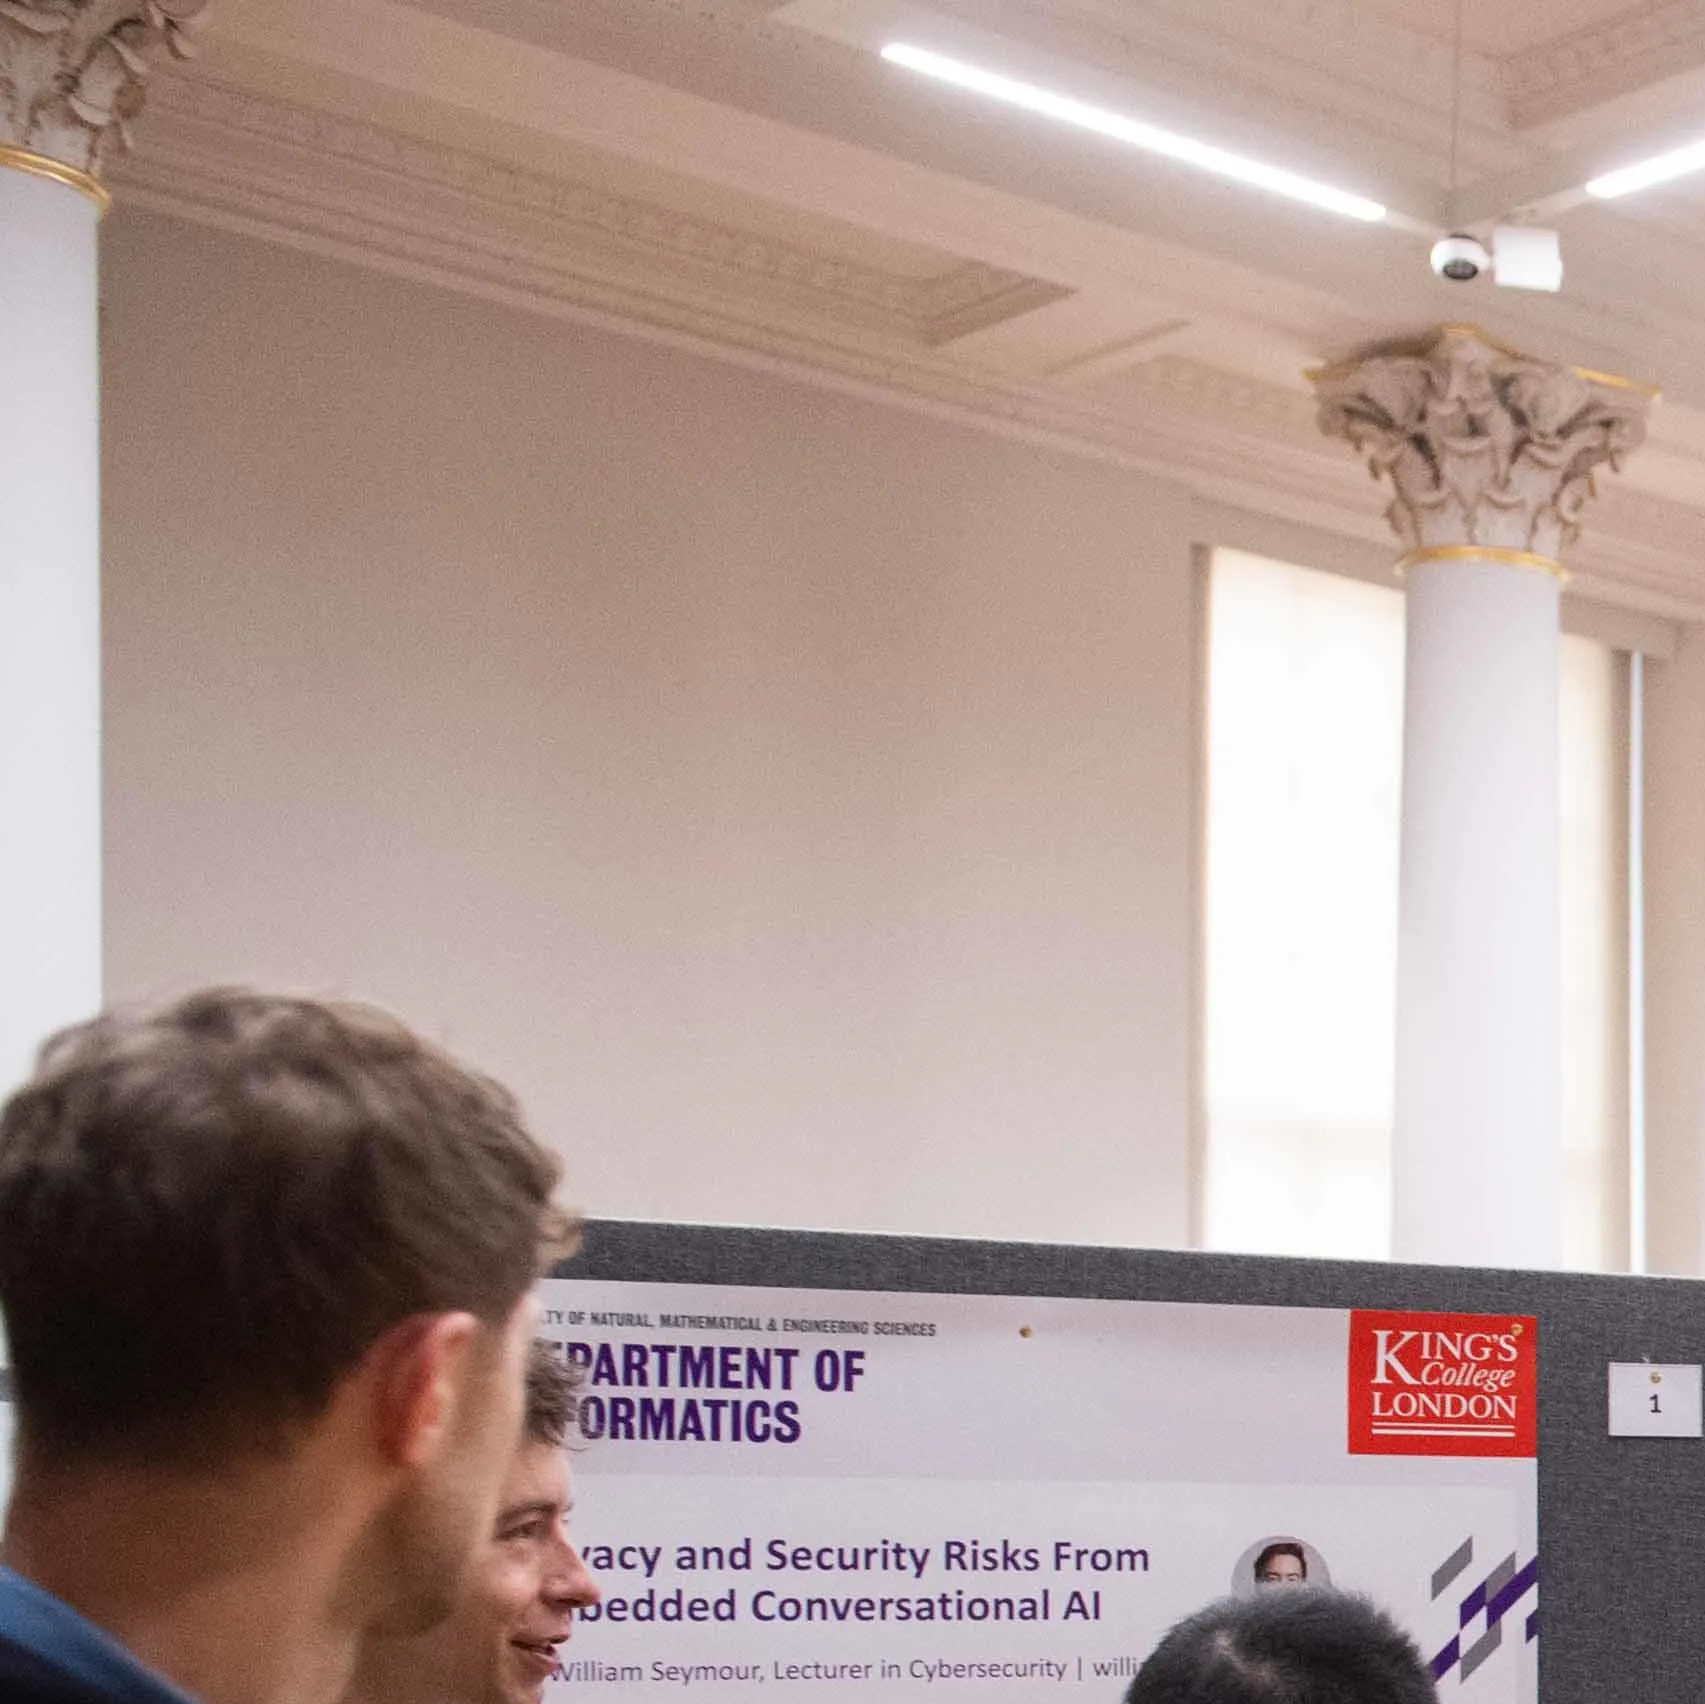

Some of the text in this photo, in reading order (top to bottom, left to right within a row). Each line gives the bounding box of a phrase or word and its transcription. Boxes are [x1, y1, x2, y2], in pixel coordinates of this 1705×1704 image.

[569, 1310, 585, 1325] OF
[659, 1313, 762, 1332] MATHEMATICAL
[766, 1317, 778, 1332] &
[782, 1318, 869, 1335] ENGINEERING
[873, 1321, 936, 1336] SCIENCES
[557, 1343, 865, 1393] PARTMENT OF
[1371, 1330, 1518, 1385] KING'S
[1420, 1362, 1516, 1392] College
[1371, 1391, 1516, 1419] LONDON
[1649, 1394, 1662, 1413] 1
[576, 1396, 802, 1444] ORMATICS
[676, 1538, 751, 1570] and
[767, 1539, 930, 1579] Security
[945, 1539, 1040, 1571] Risks
[1055, 1541, 1148, 1571] From
[752, 1588, 1049, 1622] Conversational
[1063, 1590, 1100, 1621] AI
[651, 1660, 764, 1686] Seymour,
[774, 1660, 872, 1680] Lecturer
[881, 1659, 901, 1679] in
[909, 1659, 1067, 1683] Cybersecurity
